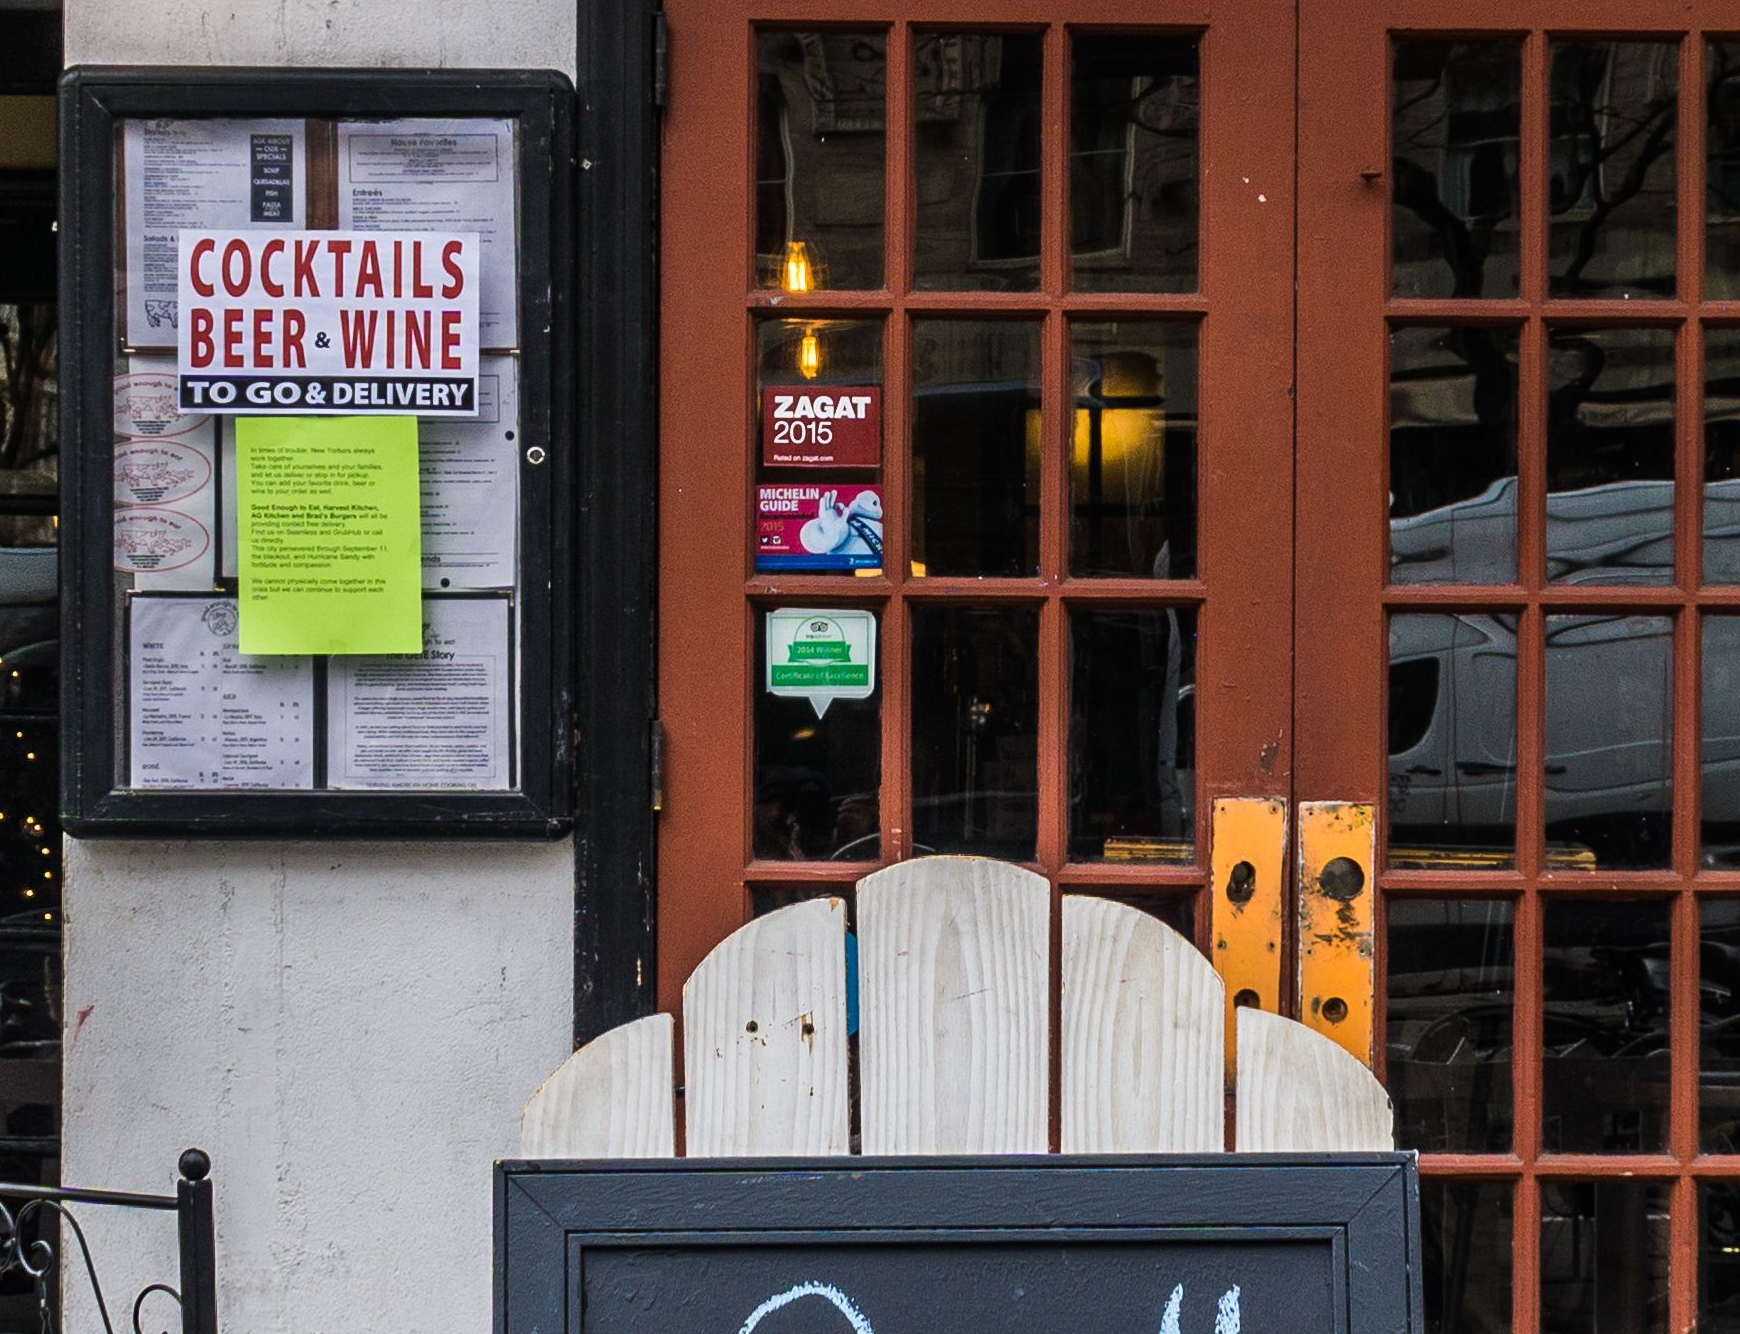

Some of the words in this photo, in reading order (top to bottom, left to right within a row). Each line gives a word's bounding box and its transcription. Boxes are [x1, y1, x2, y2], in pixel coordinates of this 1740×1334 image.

[190, 238, 464, 299] COCKTAILS
[190, 308, 307, 369] BEER
[314, 332, 330, 349] &
[340, 309, 462, 370] WINE
[187, 381, 237, 404] TO
[246, 381, 301, 404] GO
[305, 382, 327, 405] &
[332, 383, 468, 406] DELIVERY
[774, 395, 871, 418] ZAGAT
[774, 421, 833, 444] 2015
[774, 454, 792, 462] Rated
[802, 454, 834, 463] zagat.com
[760, 488, 820, 500] MICHELIN
[760, 500, 798, 511] GUIDE
[761, 521, 784, 532] 2015
[431, 650, 455, 661] Story
